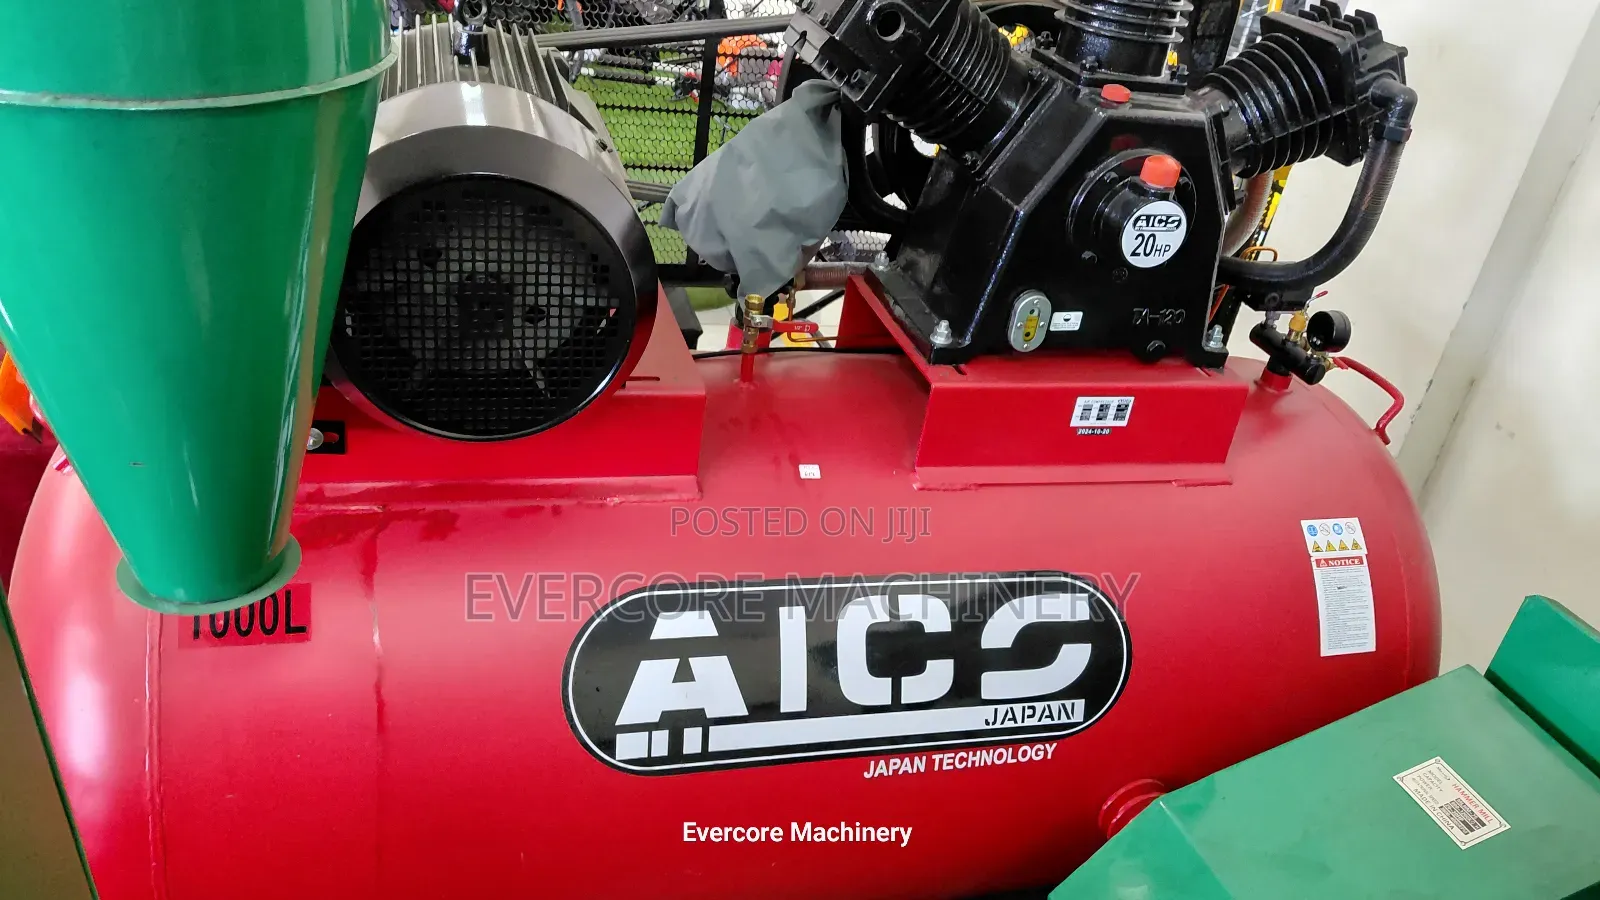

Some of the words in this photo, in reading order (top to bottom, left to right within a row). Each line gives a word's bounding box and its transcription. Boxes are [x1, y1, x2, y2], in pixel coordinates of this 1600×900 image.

[1135, 215, 1181, 227] AICS
[1328, 558, 1361, 567] NOTICE
[614, 593, 1093, 726] AICS
[984, 702, 1076, 726] JAPAN
[863, 756, 927, 779] JAPAN
[931, 743, 1058, 772] TECHNOLOGY
[1413, 788, 1431, 804] MADE
[1436, 811, 1455, 830] CHINA
[1452, 783, 1480, 810] HAMMER
[1477, 809, 1494, 824] MILL
